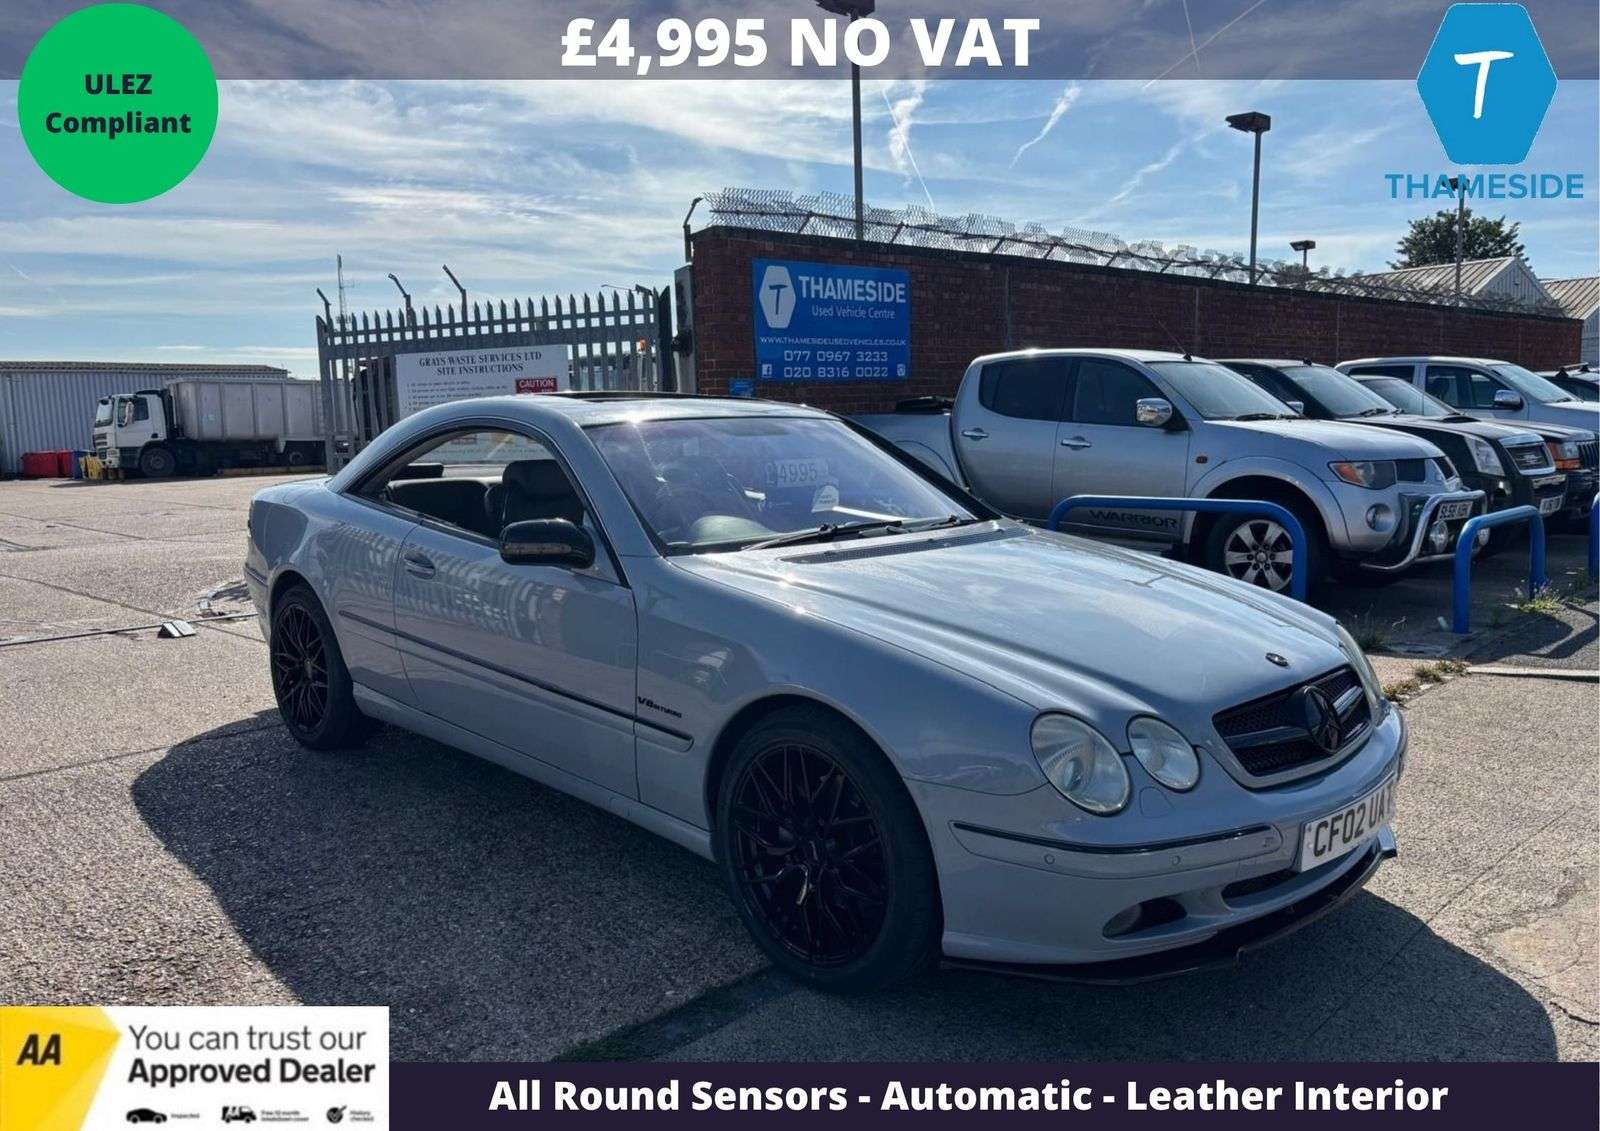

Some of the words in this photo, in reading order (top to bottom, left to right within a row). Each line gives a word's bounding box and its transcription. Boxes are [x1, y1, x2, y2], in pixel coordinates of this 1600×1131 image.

[799, 276, 906, 303] THAMESIDE
[811, 304, 834, 317] Used
[837, 304, 866, 319] Vehicle
[868, 307, 896, 319] Centre
[419, 356, 446, 367] GRAYS
[448, 355, 476, 365] WASTE
[479, 352, 522, 362] SERVICES
[525, 351, 542, 361] LTD
[784, 350, 811, 361] 077
[816, 351, 850, 361] 0967
[856, 352, 888, 361] 3233
[436, 366, 456, 376] SITE
[459, 363, 524, 374] INSTRUCTIONS
[783, 367, 811, 377] 020
[817, 367, 849, 377] 8316
[855, 367, 888, 377] 0022
[519, 379, 555, 389] CAUTION
[1088, 510, 1178, 529] WARRIOR
[1314, 802, 1366, 857] CF02
